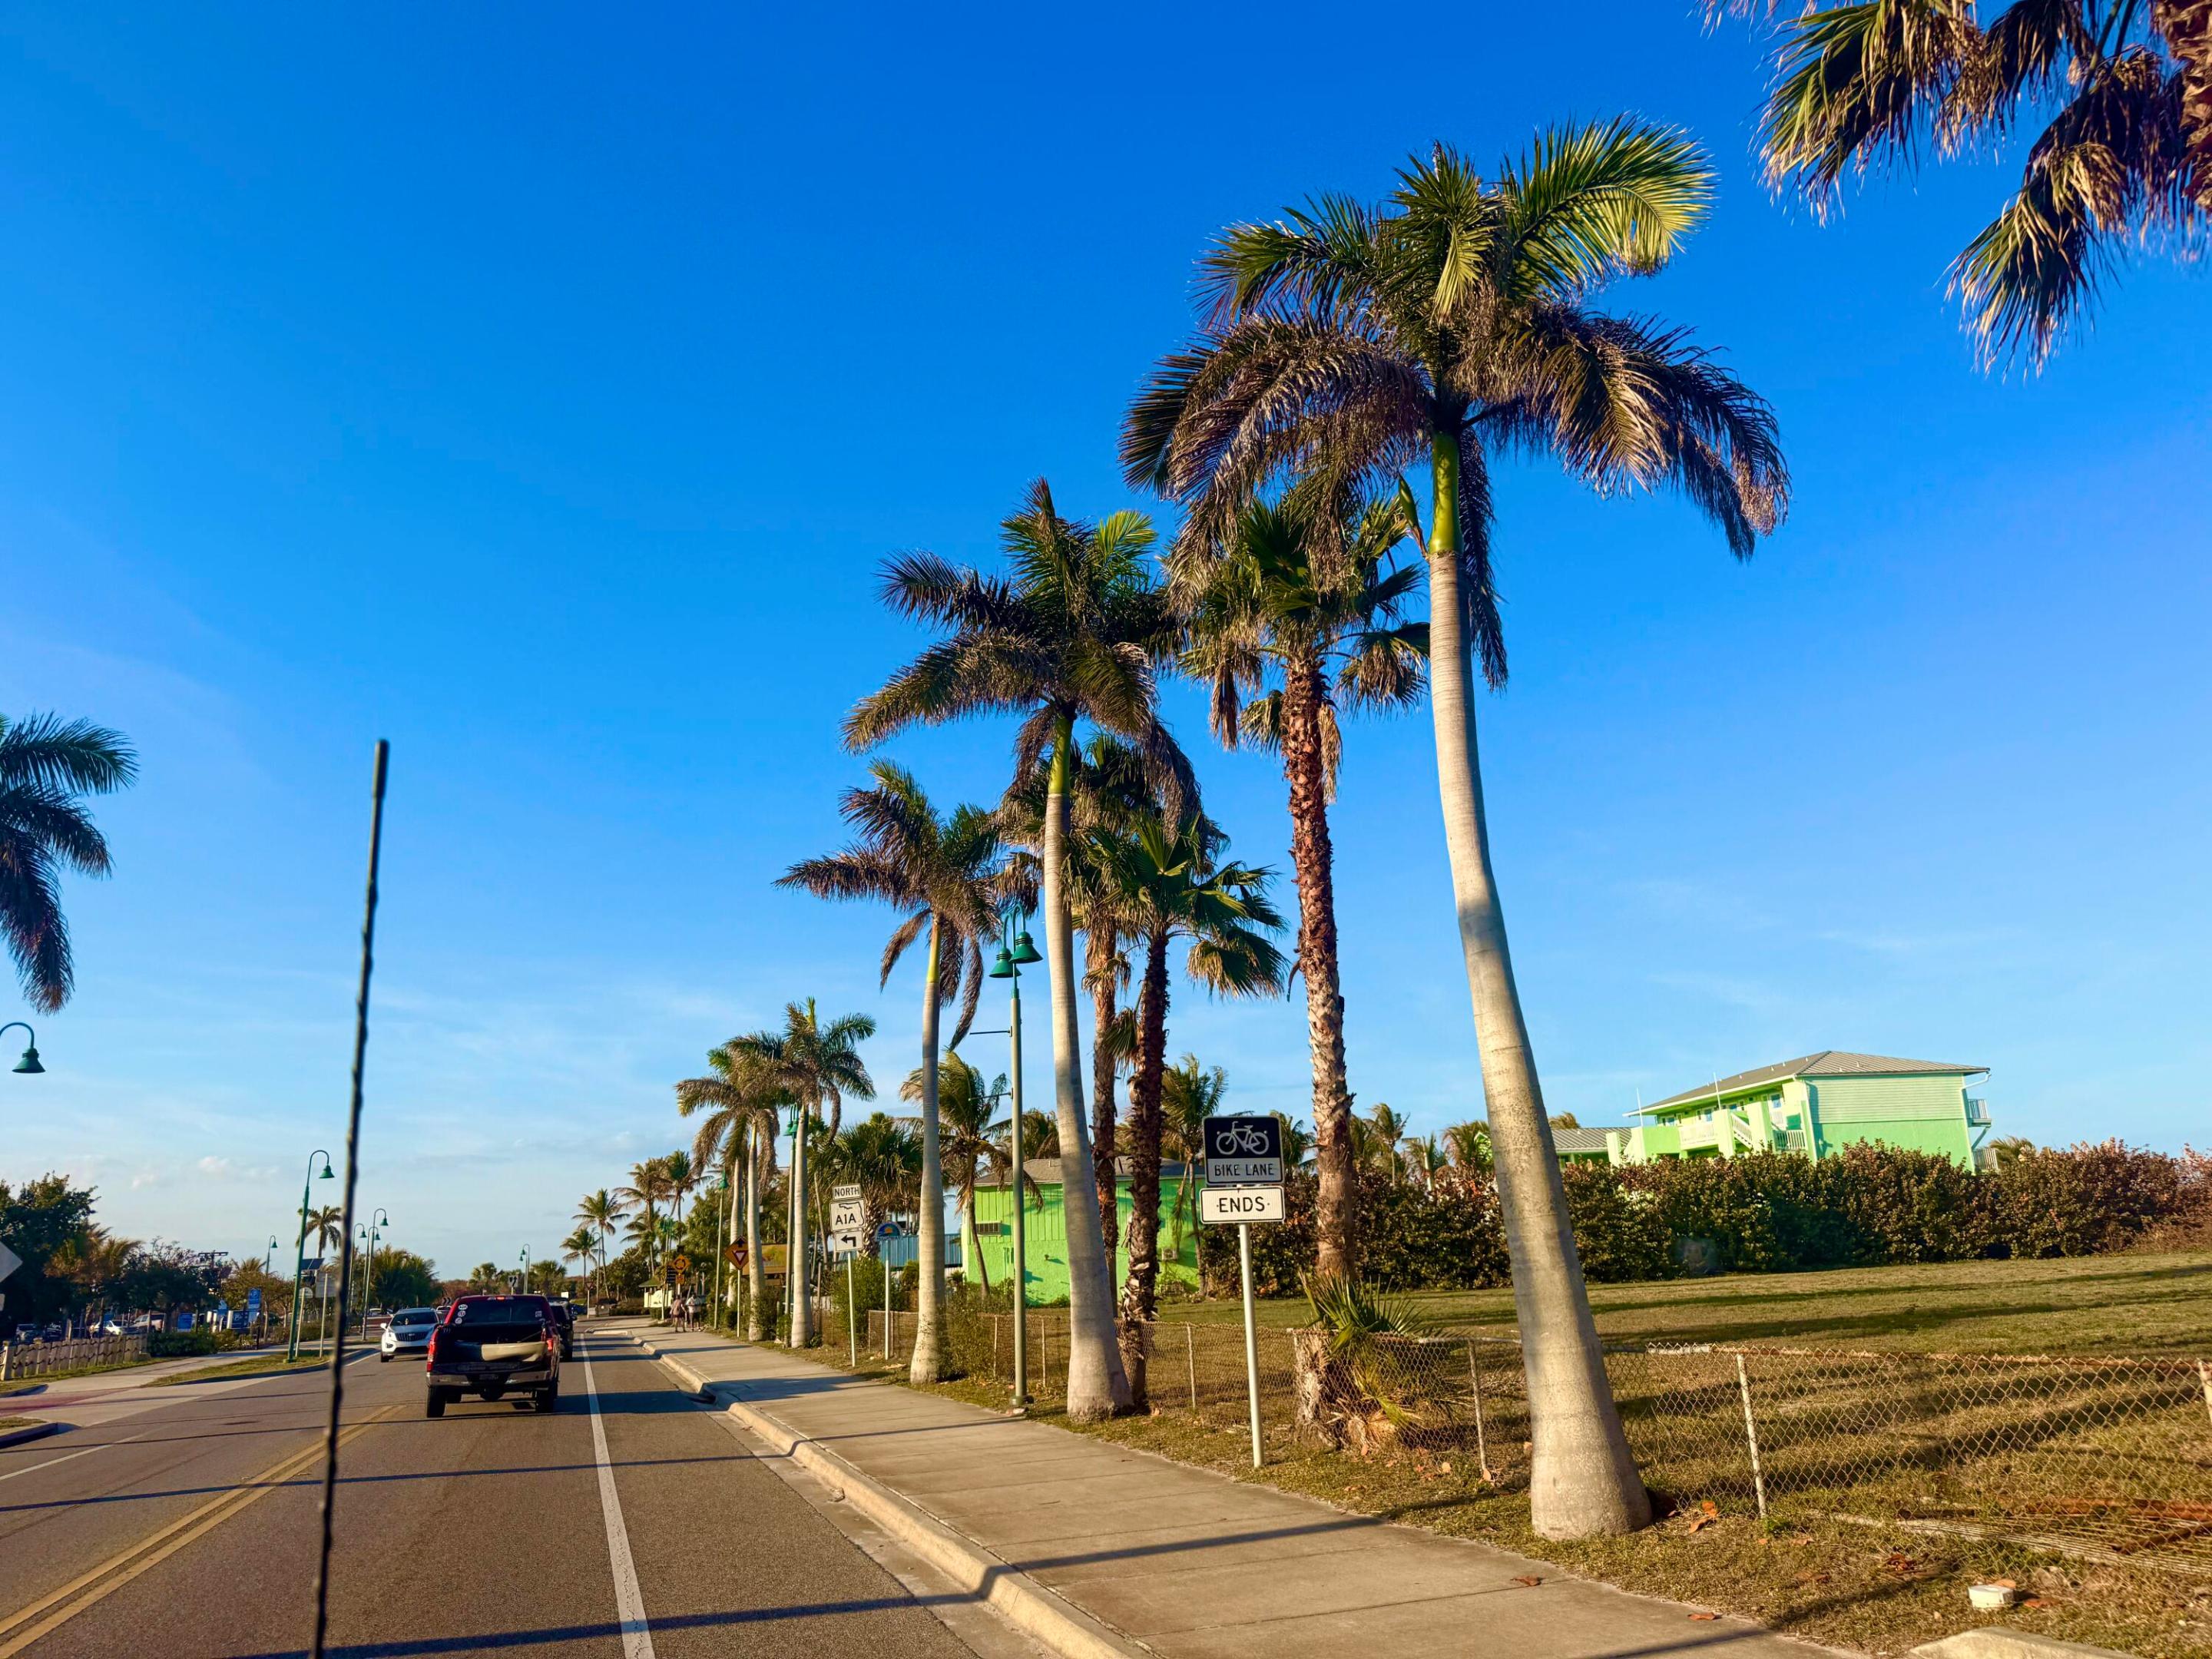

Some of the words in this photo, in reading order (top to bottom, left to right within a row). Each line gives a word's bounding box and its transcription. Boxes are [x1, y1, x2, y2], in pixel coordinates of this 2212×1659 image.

[1214, 1164, 1240, 1177] BIKE
[1245, 1163, 1274, 1176] LANE
[834, 1187, 859, 1197] NORTH
[1219, 1196, 1265, 1213] ENDS
[835, 1213, 856, 1226] A1A
